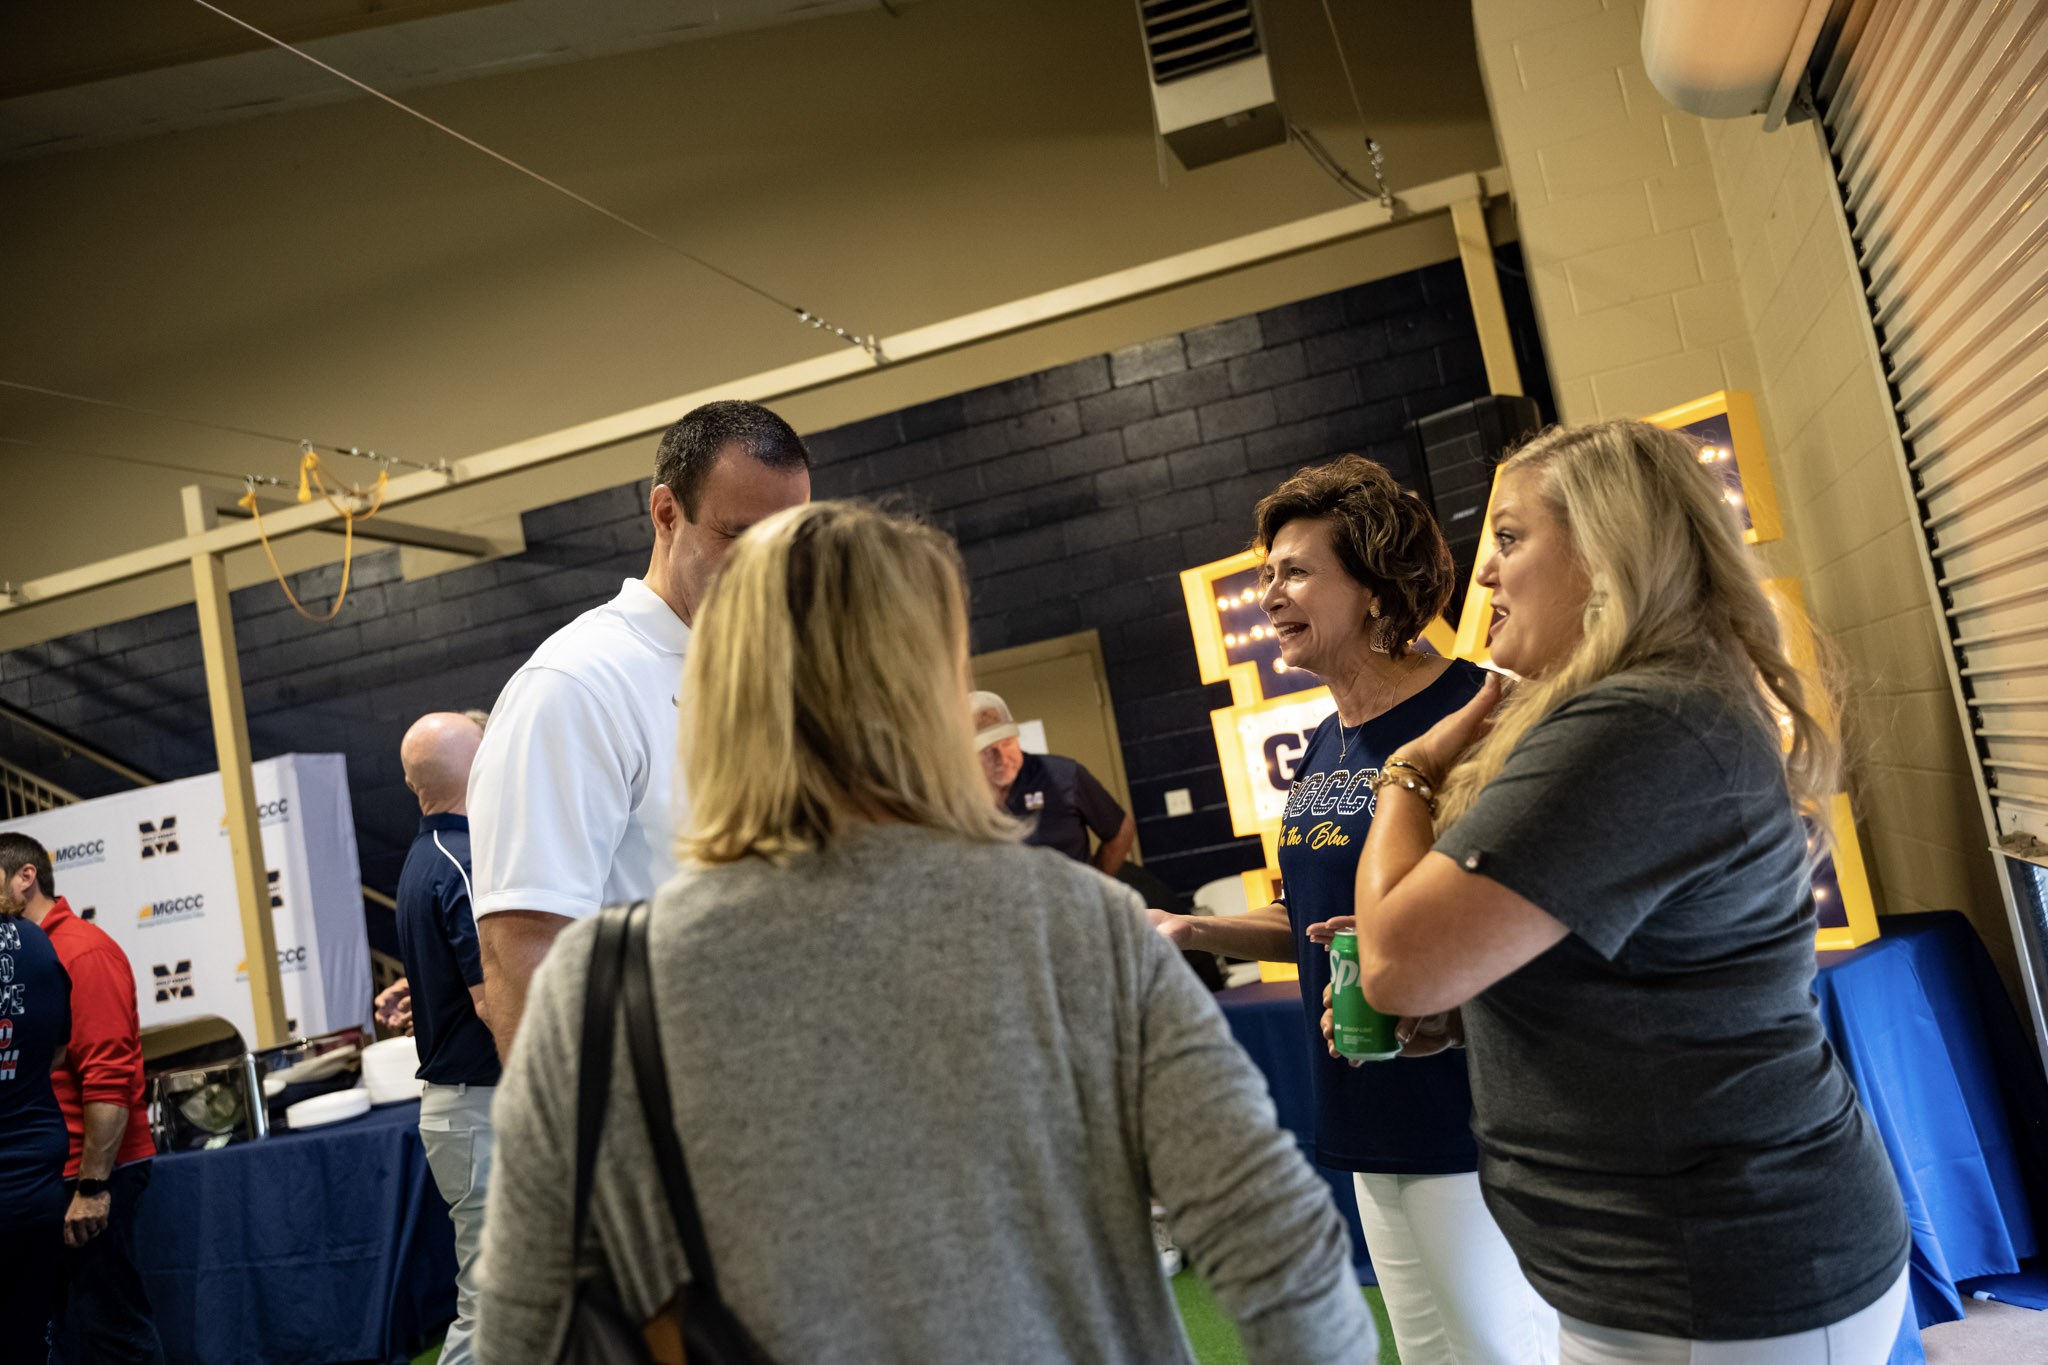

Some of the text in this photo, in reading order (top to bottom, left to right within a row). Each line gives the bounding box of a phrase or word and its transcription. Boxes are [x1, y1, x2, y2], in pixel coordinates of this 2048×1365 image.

[1263, 727, 1317, 791] G
[1284, 768, 1379, 820] GCC
[256, 798, 288, 818] CCC
[1287, 826, 1302, 846] the
[1306, 821, 1350, 850] Blue
[56, 839, 105, 862] MGCCC
[152, 894, 204, 916] MGCCC
